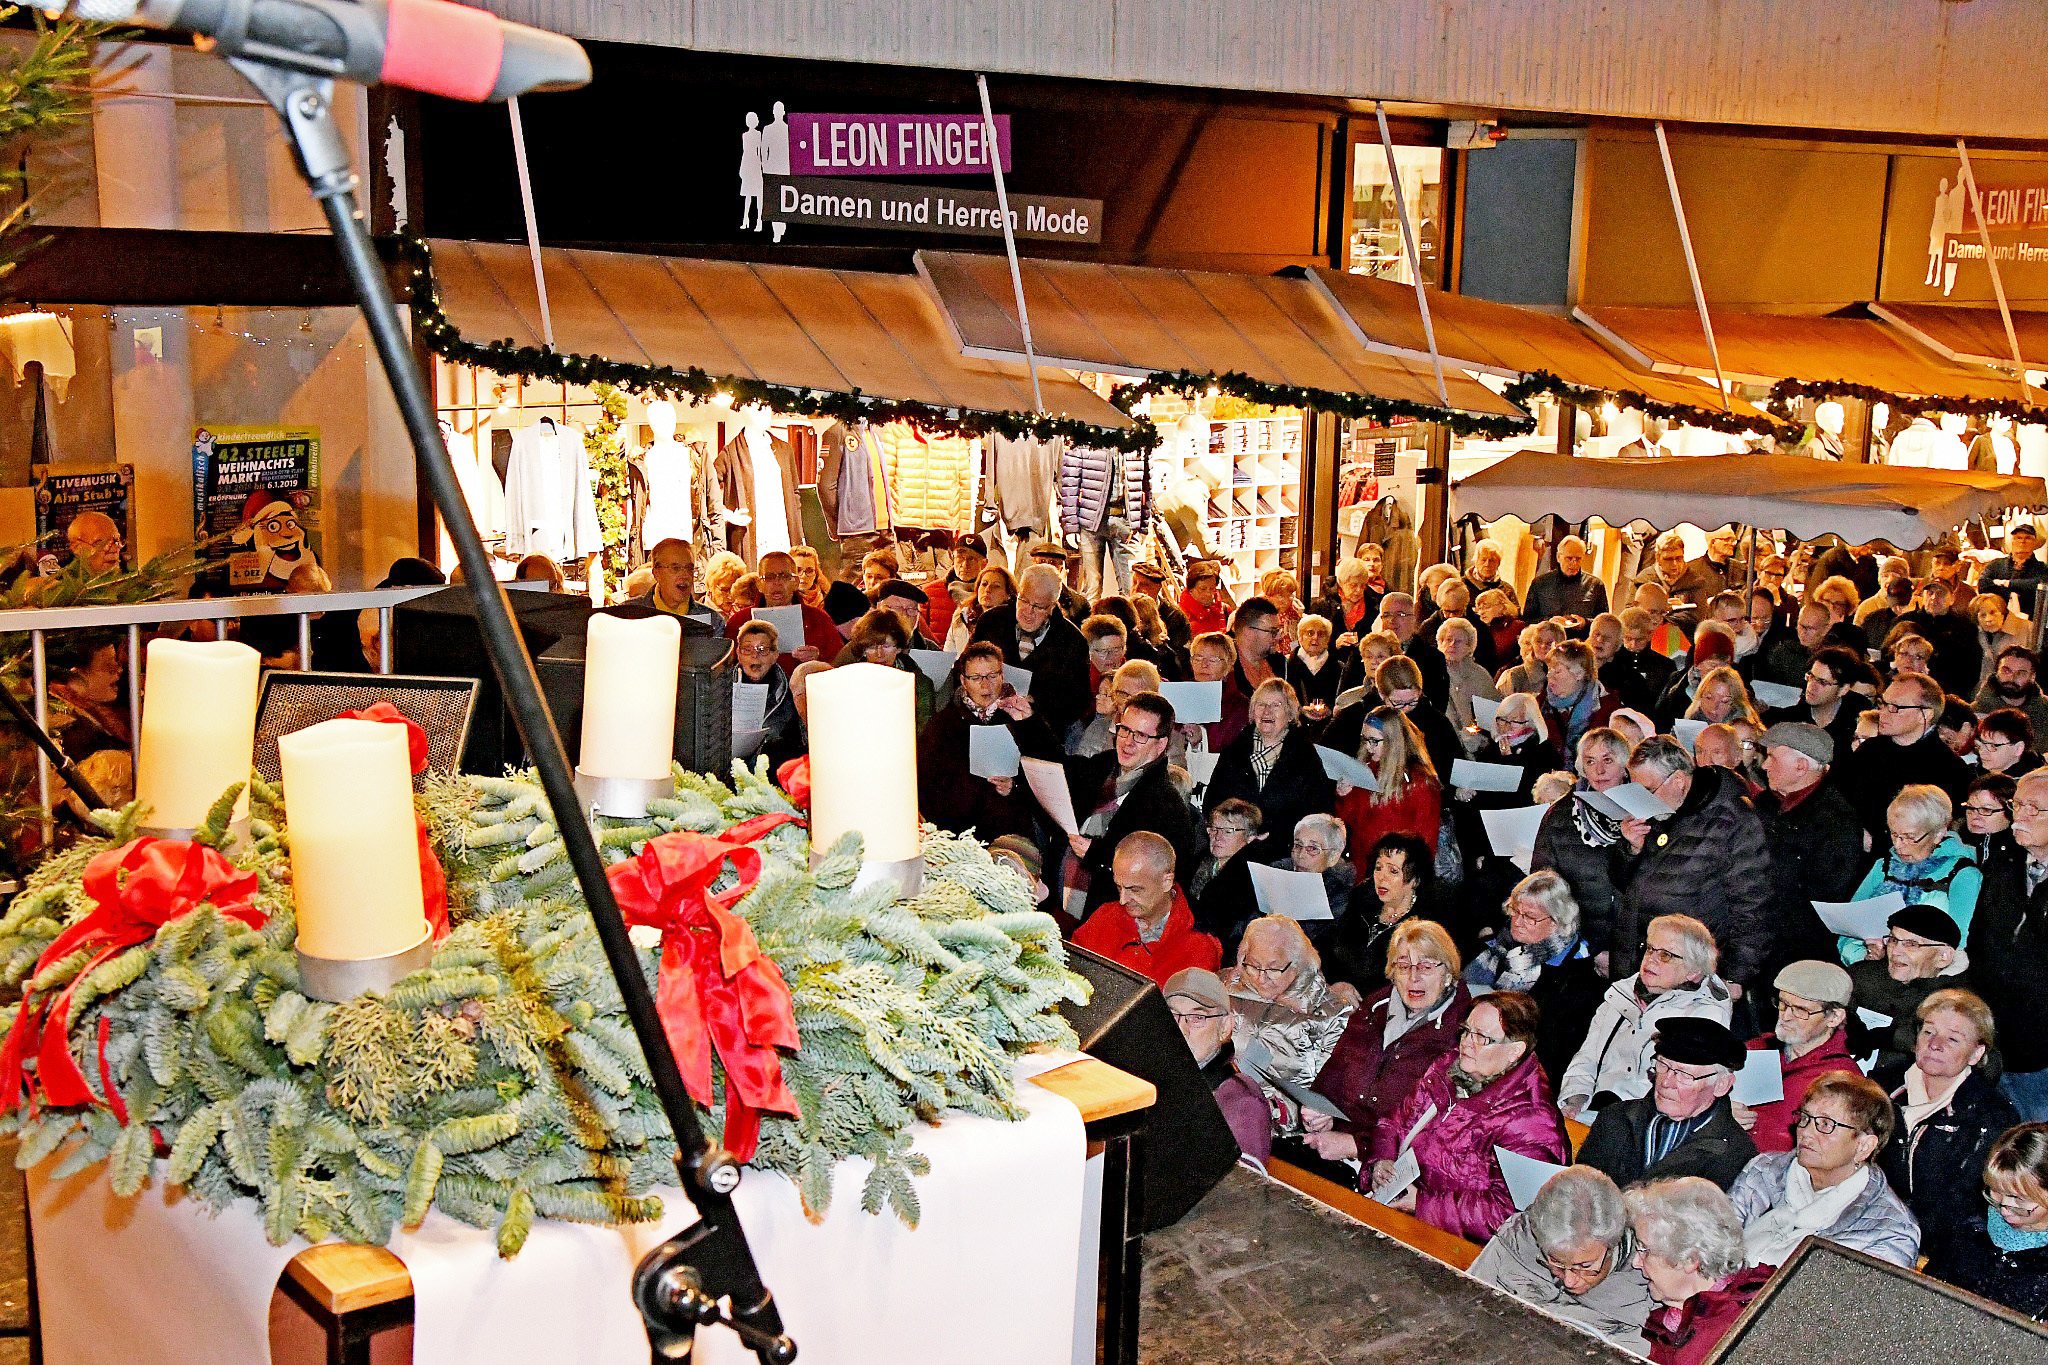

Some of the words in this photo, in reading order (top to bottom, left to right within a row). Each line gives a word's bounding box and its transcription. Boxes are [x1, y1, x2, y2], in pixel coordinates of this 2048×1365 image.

[812, 123, 888, 167] LEON
[780, 185, 872, 219] Damen
[881, 197, 929, 223] und
[937, 199, 1018, 230] Herren
[1026, 205, 1089, 235] Mode
[1992, 242, 2016, 260] und
[218, 447, 245, 463] 42.
[246, 444, 306, 461] STEELER
[218, 458, 296, 474] WEIHNACHTS
[55, 474, 117, 489] LIVEMUSIK
[195, 455, 206, 511] musikalisch
[217, 472, 261, 486] MARKT
[267, 479, 299, 490] 6.1.2019
[53, 491, 80, 504] Alm
